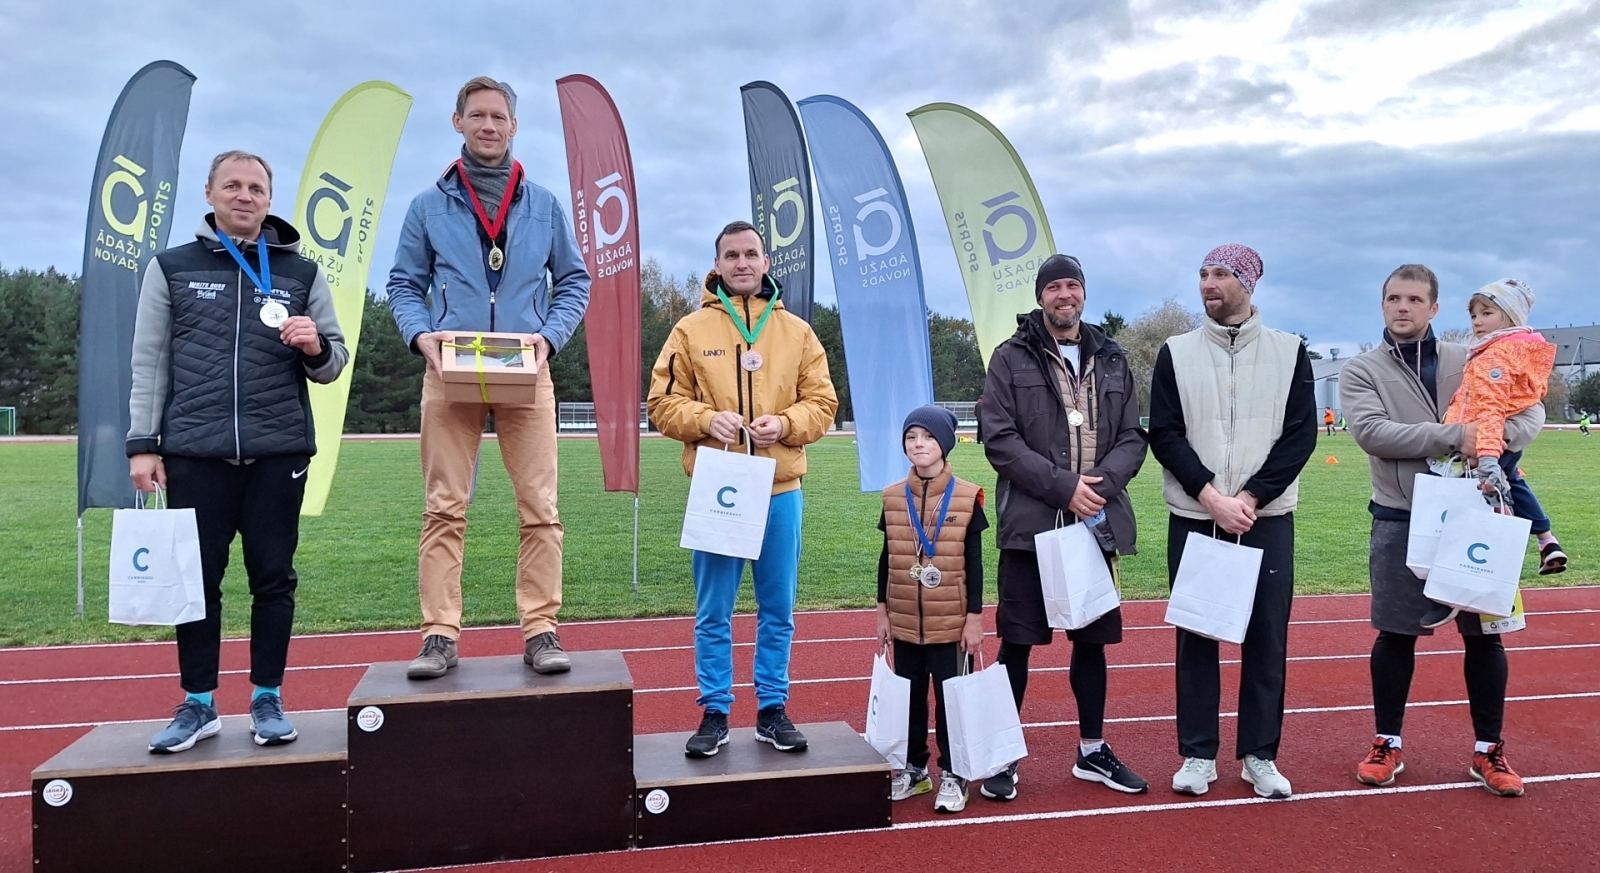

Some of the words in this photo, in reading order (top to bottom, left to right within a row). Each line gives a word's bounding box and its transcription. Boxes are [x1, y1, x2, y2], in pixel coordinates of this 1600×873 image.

[149, 180, 171, 251] SPORTS
[96, 229, 141, 259] ĀDAŽU
[94, 247, 138, 273] NOVADS
[299, 244, 343, 273] ĀDAŽU
[717, 486, 738, 508] C
[133, 547, 149, 572] C
[1467, 543, 1490, 564] C
